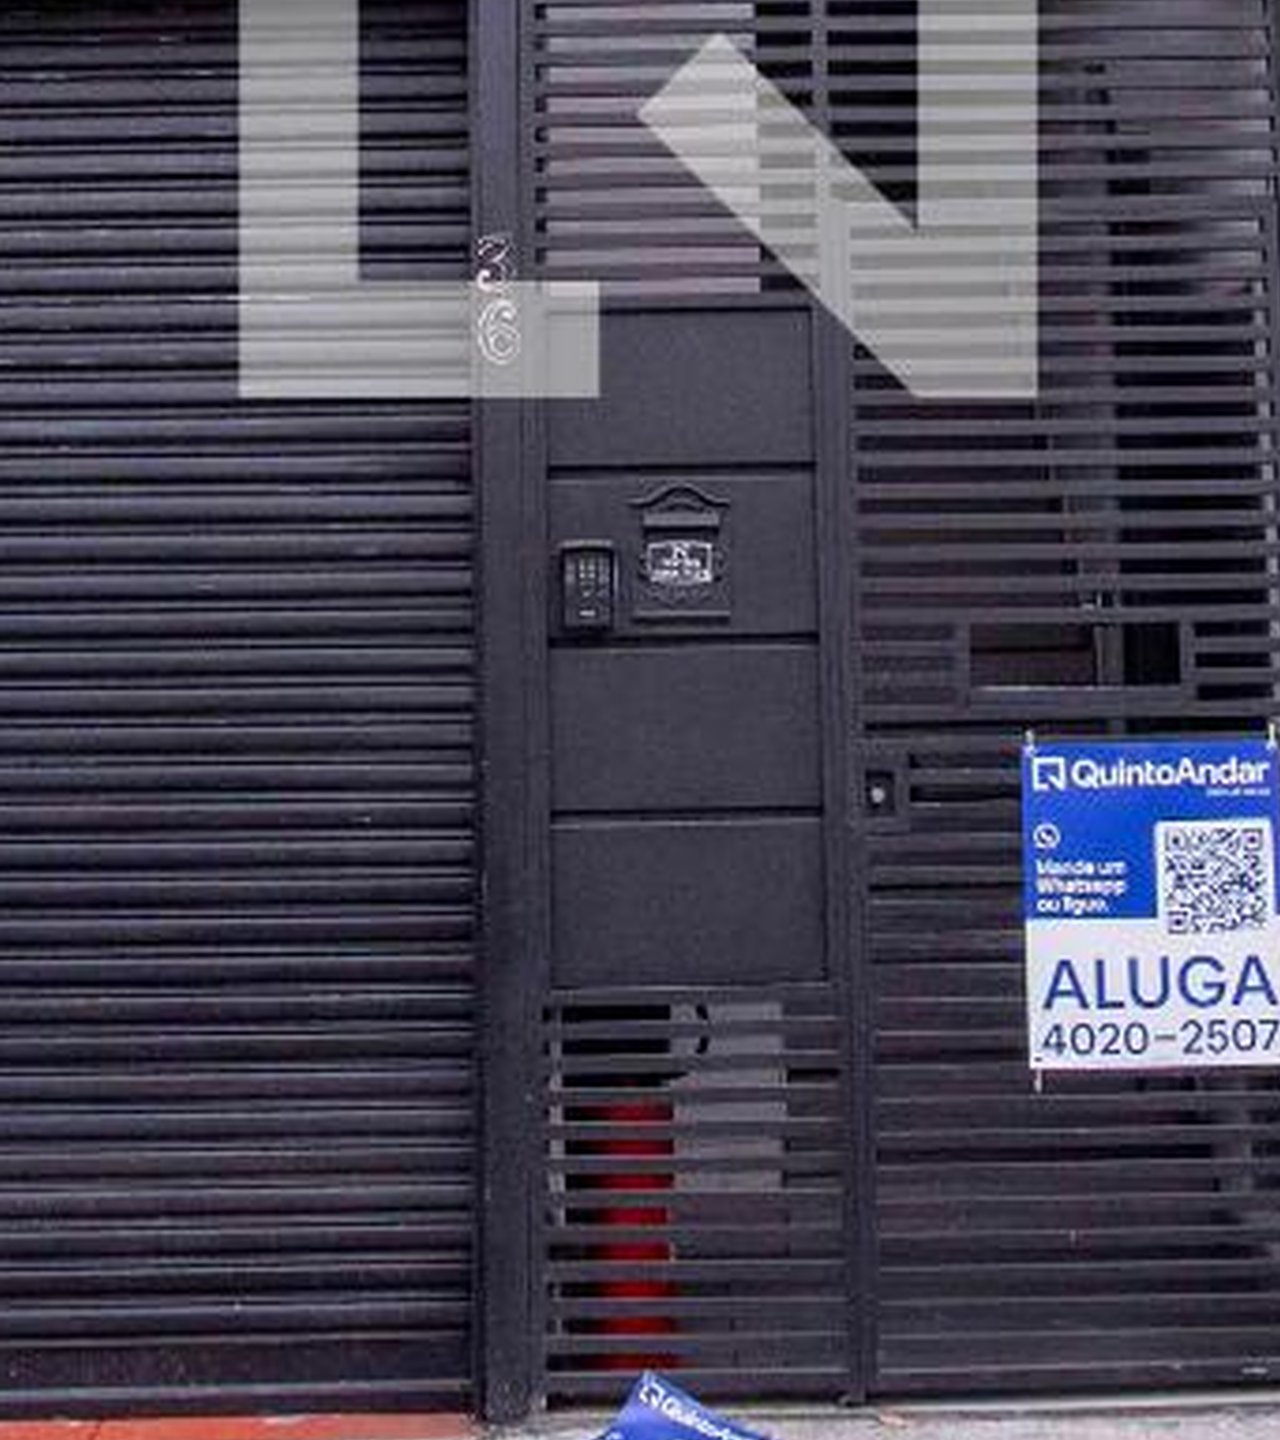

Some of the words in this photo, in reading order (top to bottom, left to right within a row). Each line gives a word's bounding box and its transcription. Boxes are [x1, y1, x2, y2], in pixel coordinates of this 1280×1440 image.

[1071, 755, 1270, 788] QuintoAndar
[1042, 954, 1279, 1011] ALUGA
[1041, 1018, 1280, 1057] 4020-2507
